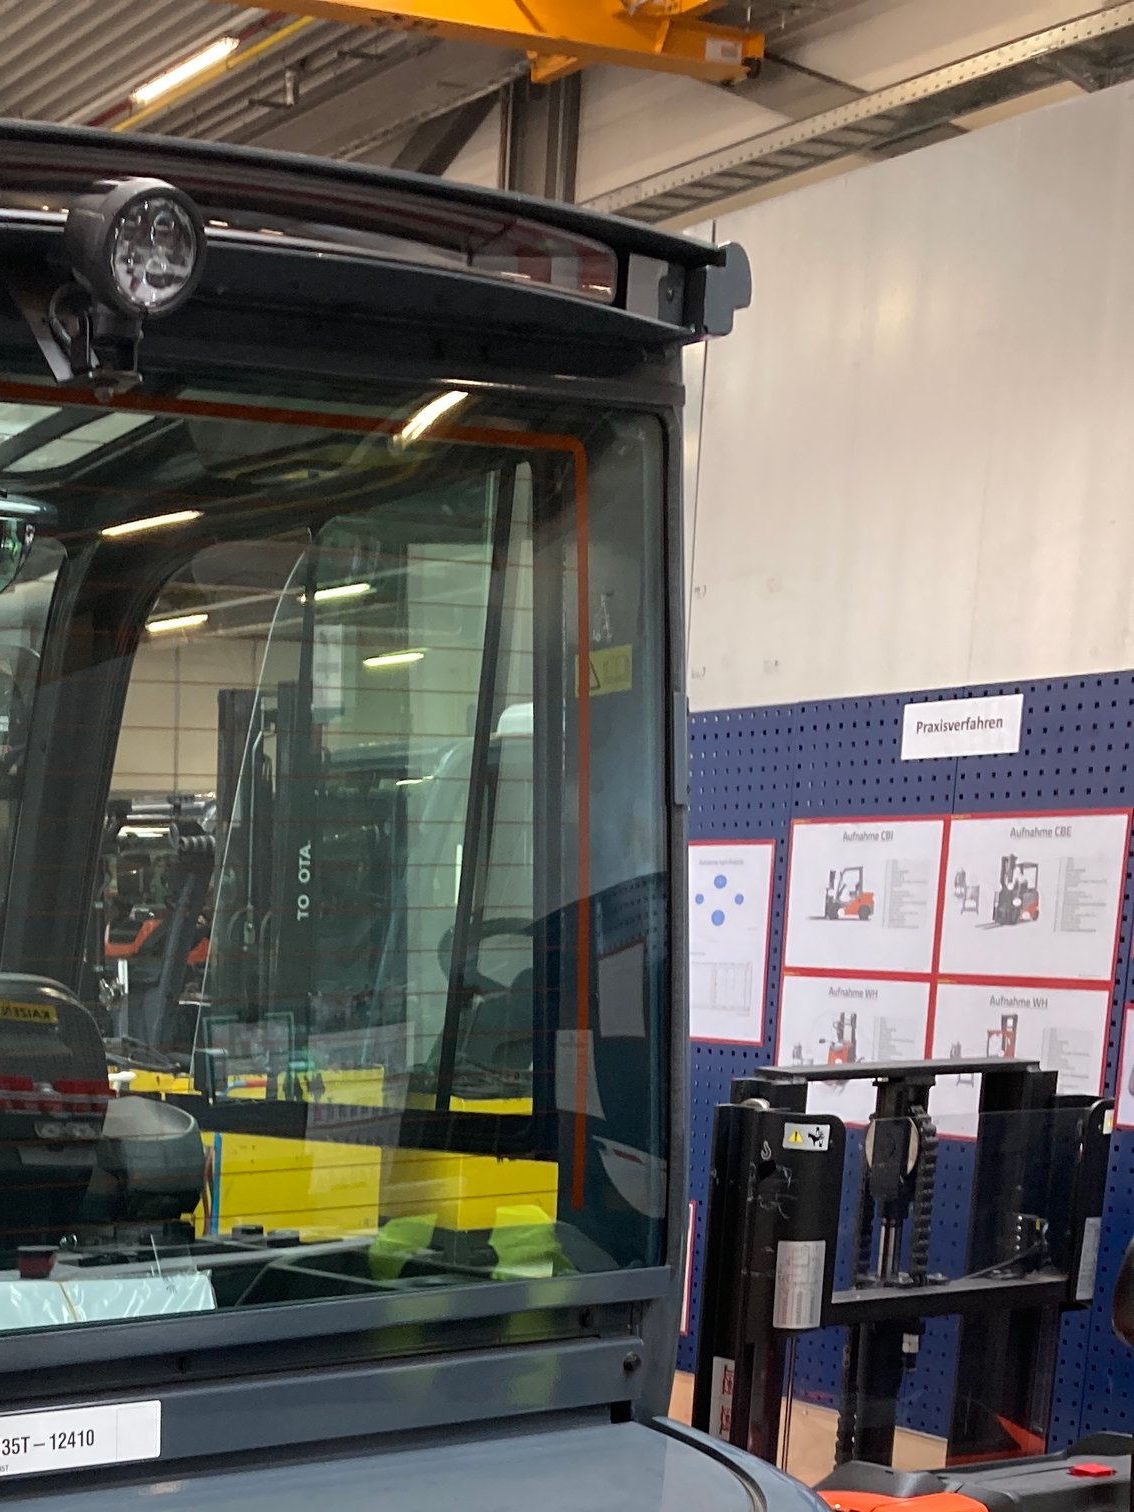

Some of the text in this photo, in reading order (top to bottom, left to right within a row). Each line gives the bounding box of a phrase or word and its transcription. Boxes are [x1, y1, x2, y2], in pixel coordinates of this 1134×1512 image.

[915, 715, 1004, 735] Praxisverfahren
[843, 831, 880, 842] Aufnahme
[1009, 826, 1053, 841] Aufnahme
[828, 986, 864, 999] Aufnahme
[989, 995, 1049, 1009] Aufnahme WH
